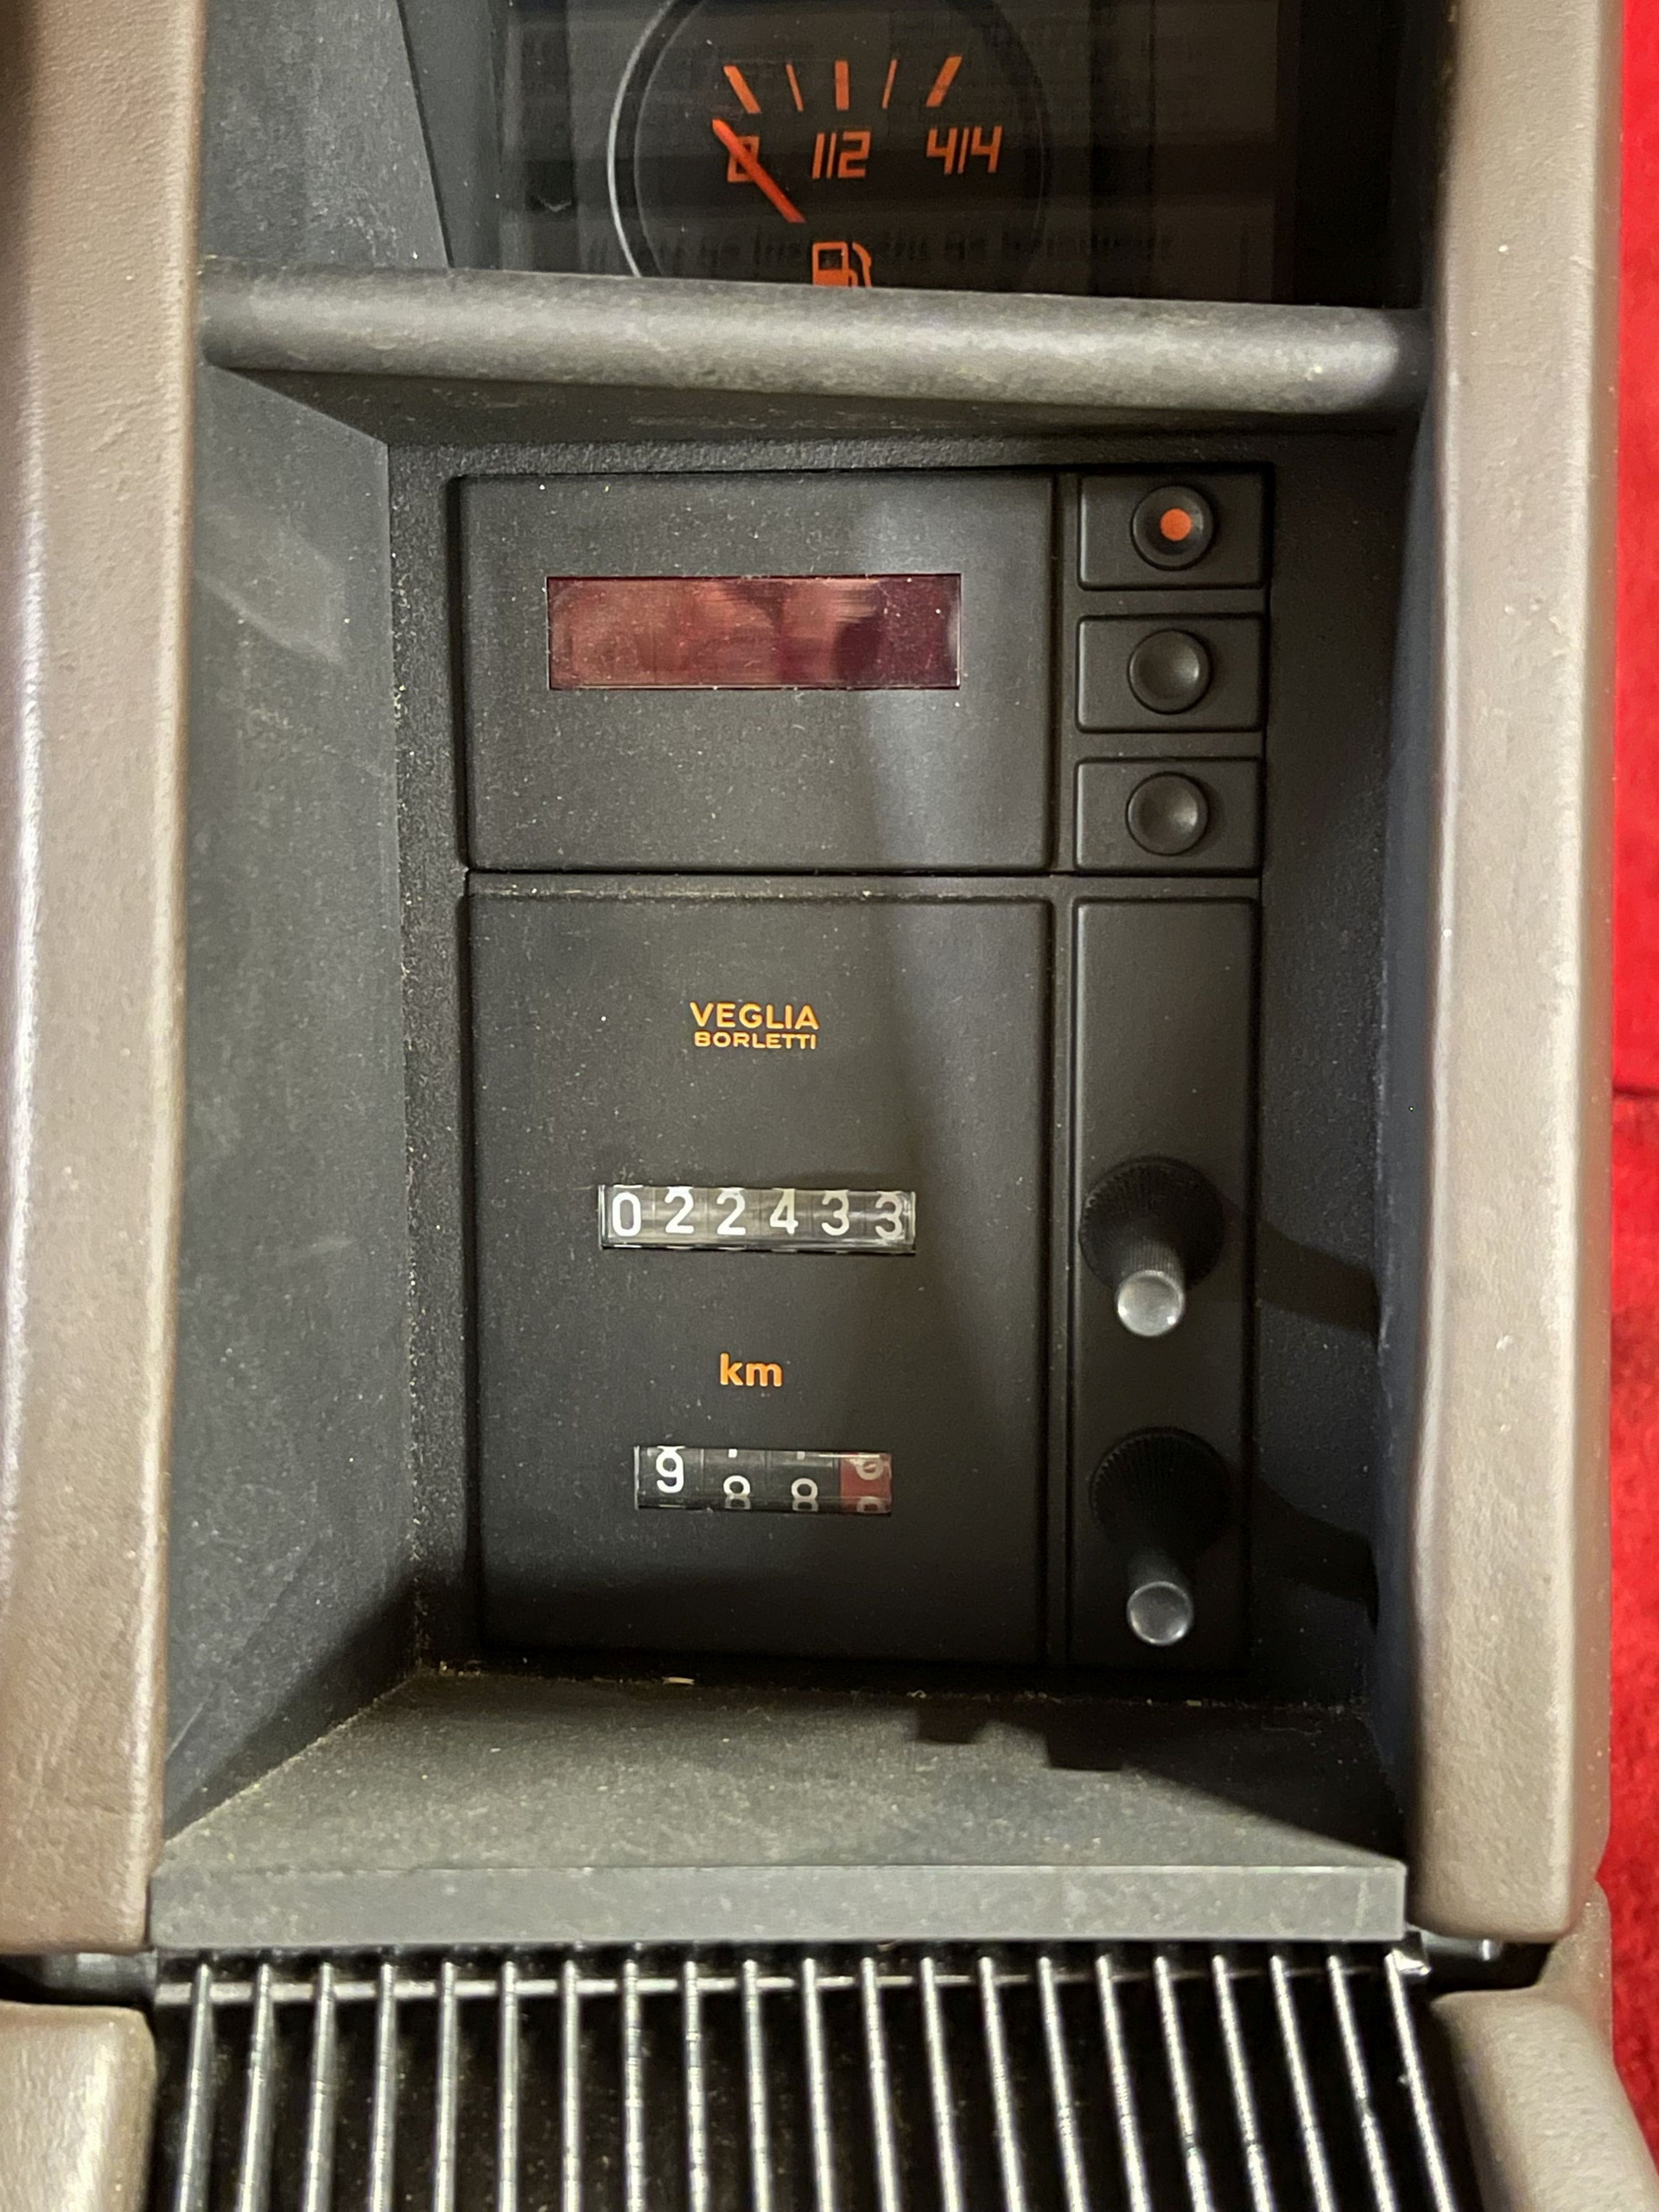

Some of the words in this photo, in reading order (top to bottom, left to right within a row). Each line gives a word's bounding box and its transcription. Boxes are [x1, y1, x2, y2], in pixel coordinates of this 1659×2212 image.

[690, 1001, 819, 1030] VEGLIA
[694, 1031, 817, 1050] BORLETTI
[611, 1186, 904, 1240] 022433
[720, 1352, 783, 1387] km
